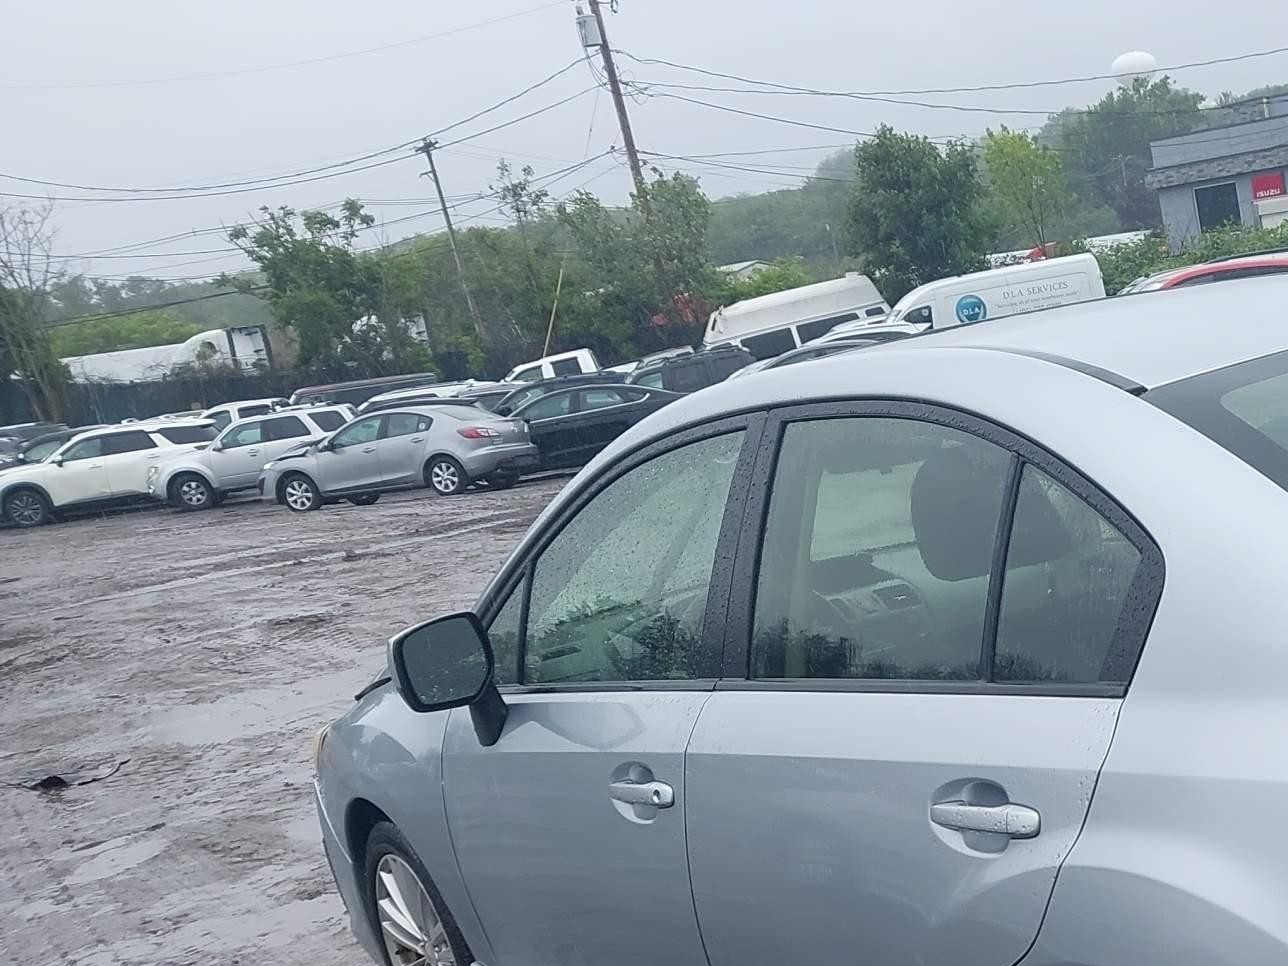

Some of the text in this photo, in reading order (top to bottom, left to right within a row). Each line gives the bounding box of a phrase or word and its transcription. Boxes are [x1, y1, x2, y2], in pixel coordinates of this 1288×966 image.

[1256, 187, 1281, 198] ISUZU
[1002, 288, 1024, 300] DLA
[1026, 281, 1069, 296] SERVICES
[962, 306, 981, 315] DLA
